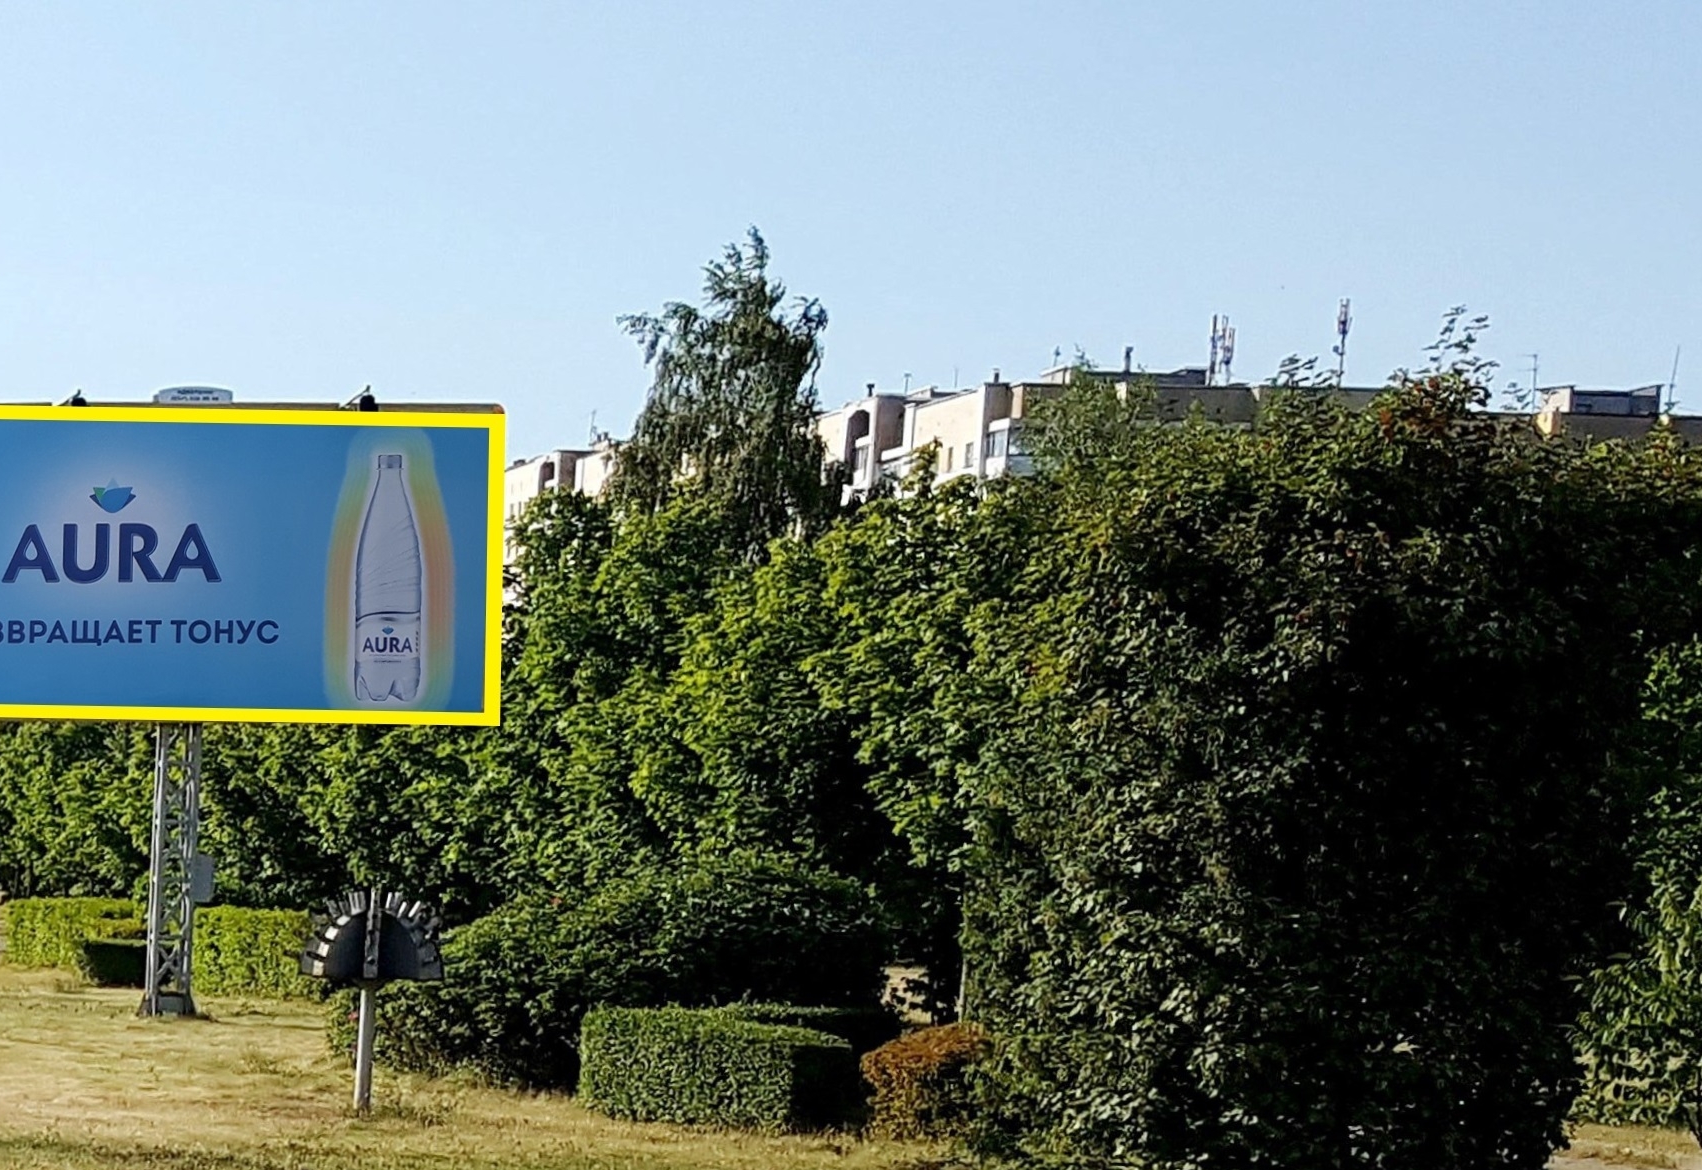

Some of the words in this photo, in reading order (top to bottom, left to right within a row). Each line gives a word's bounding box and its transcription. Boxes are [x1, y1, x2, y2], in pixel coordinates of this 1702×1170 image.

[1, 523, 222, 584] AURA
[170, 620, 280, 645] ТОНУС
[362, 637, 413, 653] AURA
